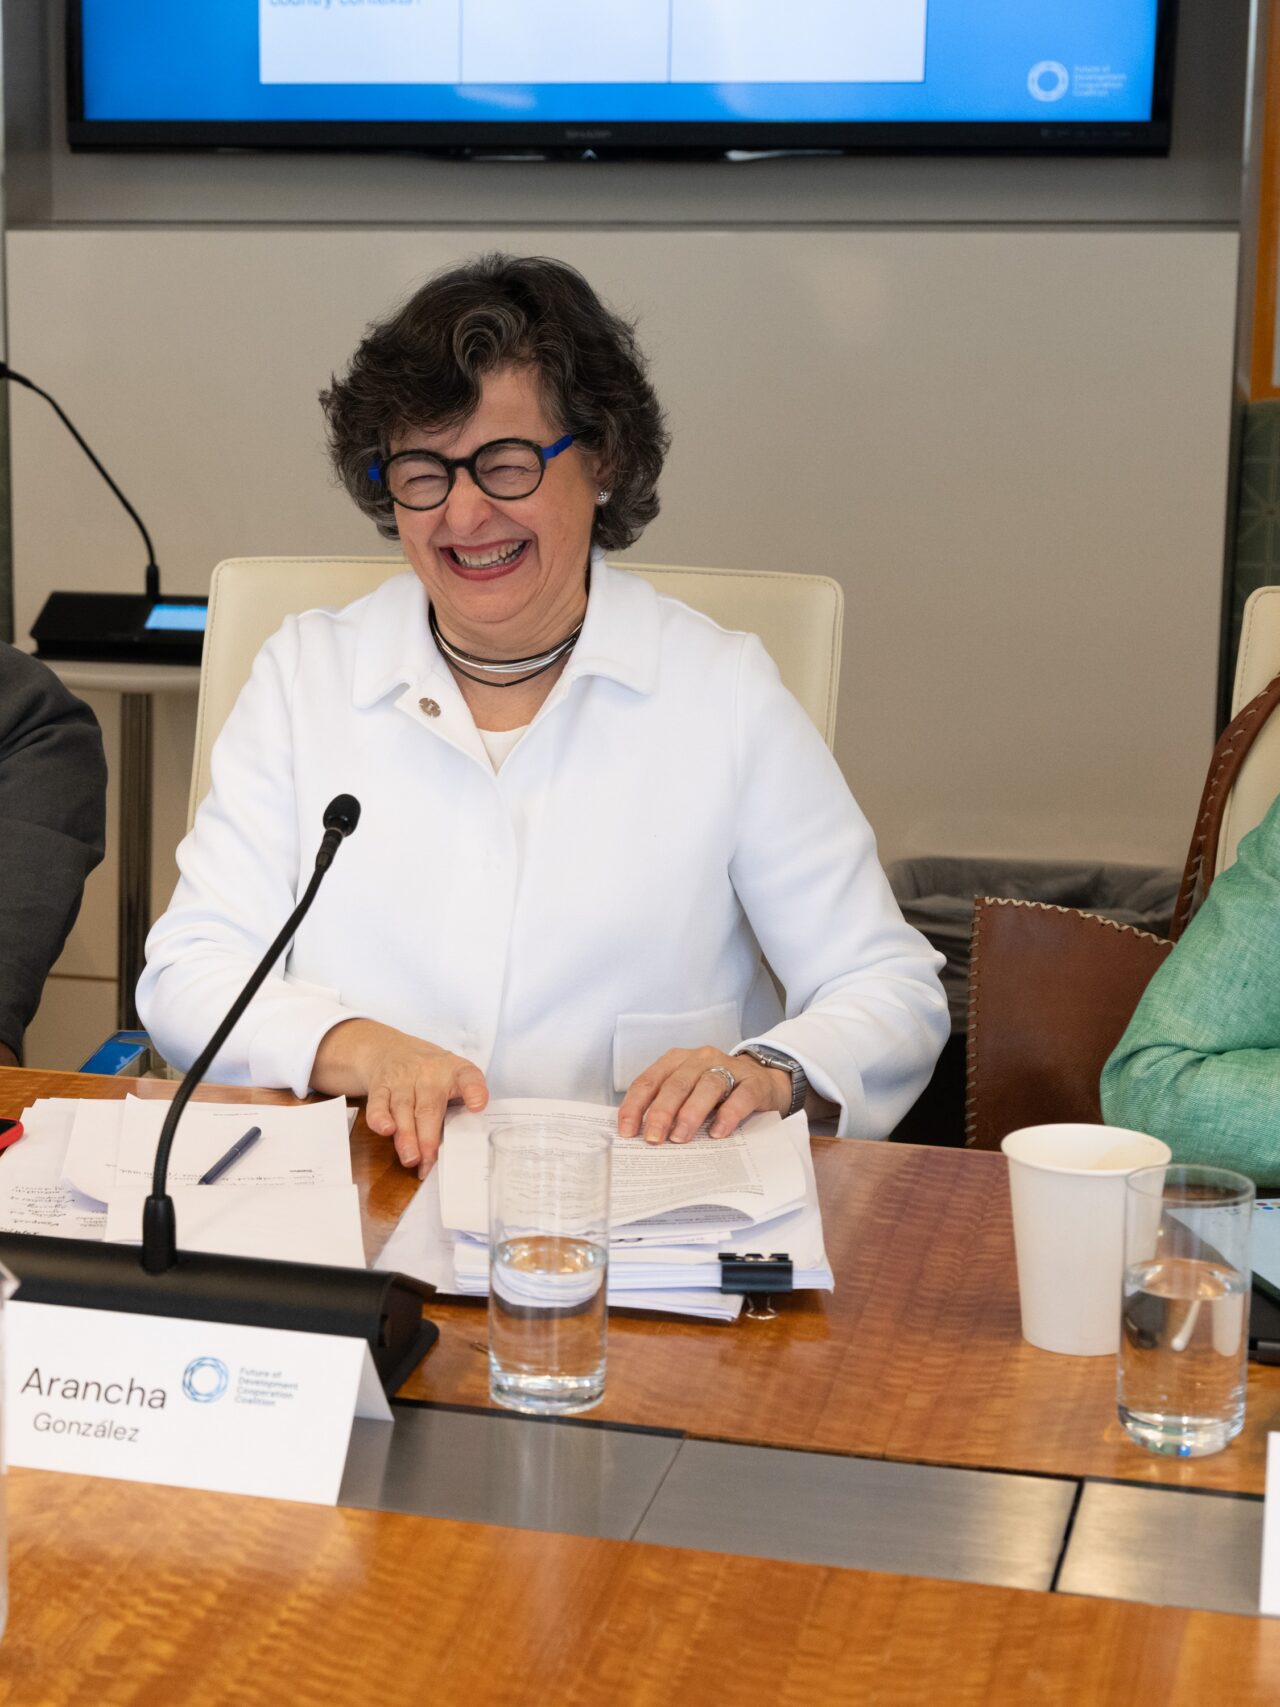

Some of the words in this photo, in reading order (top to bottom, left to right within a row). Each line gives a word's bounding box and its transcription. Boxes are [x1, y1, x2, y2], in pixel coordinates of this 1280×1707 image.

[240, 1366, 269, 1378] Future
[272, 1370, 283, 1379] of
[20, 1367, 167, 1409] Arancha
[238, 1376, 299, 1391] Development
[236, 1386, 294, 1400] Cooperation
[234, 1395, 276, 1407] Coalition
[33, 1411, 140, 1443] González
